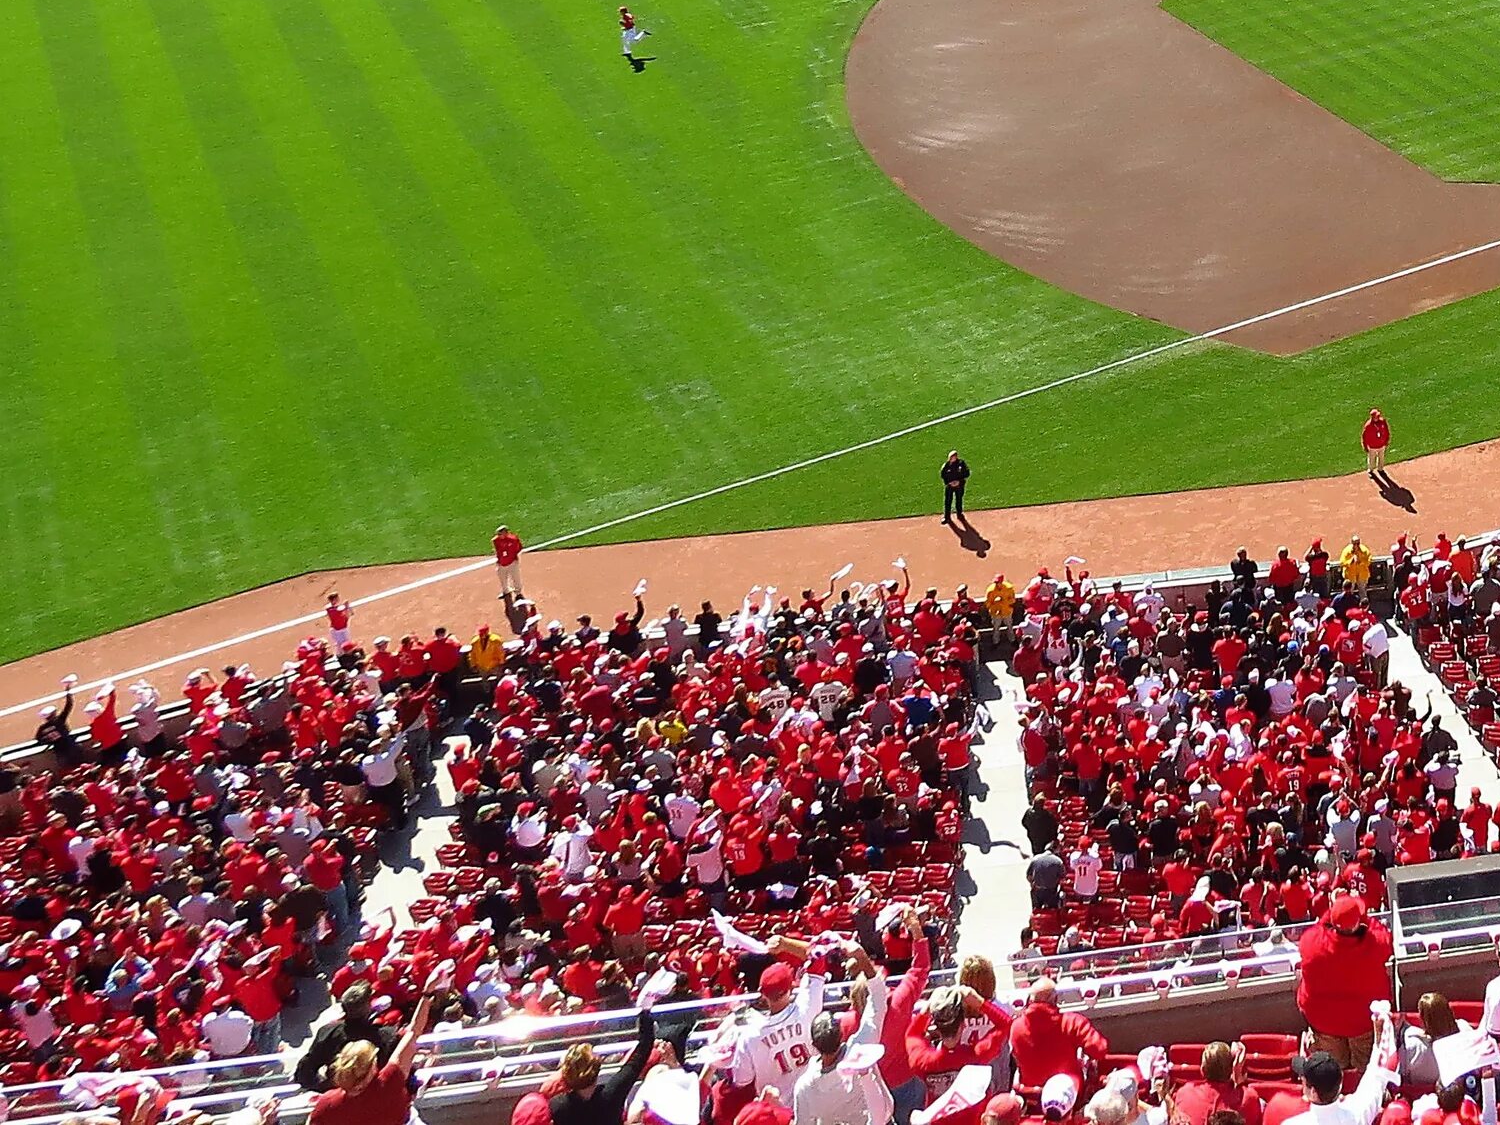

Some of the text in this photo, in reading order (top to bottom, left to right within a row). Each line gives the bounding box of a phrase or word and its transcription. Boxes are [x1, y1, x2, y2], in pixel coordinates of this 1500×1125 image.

[1288, 779, 1300, 791] 19
[761, 1023, 802, 1048] VOTTO
[773, 1043, 812, 1076] 19
